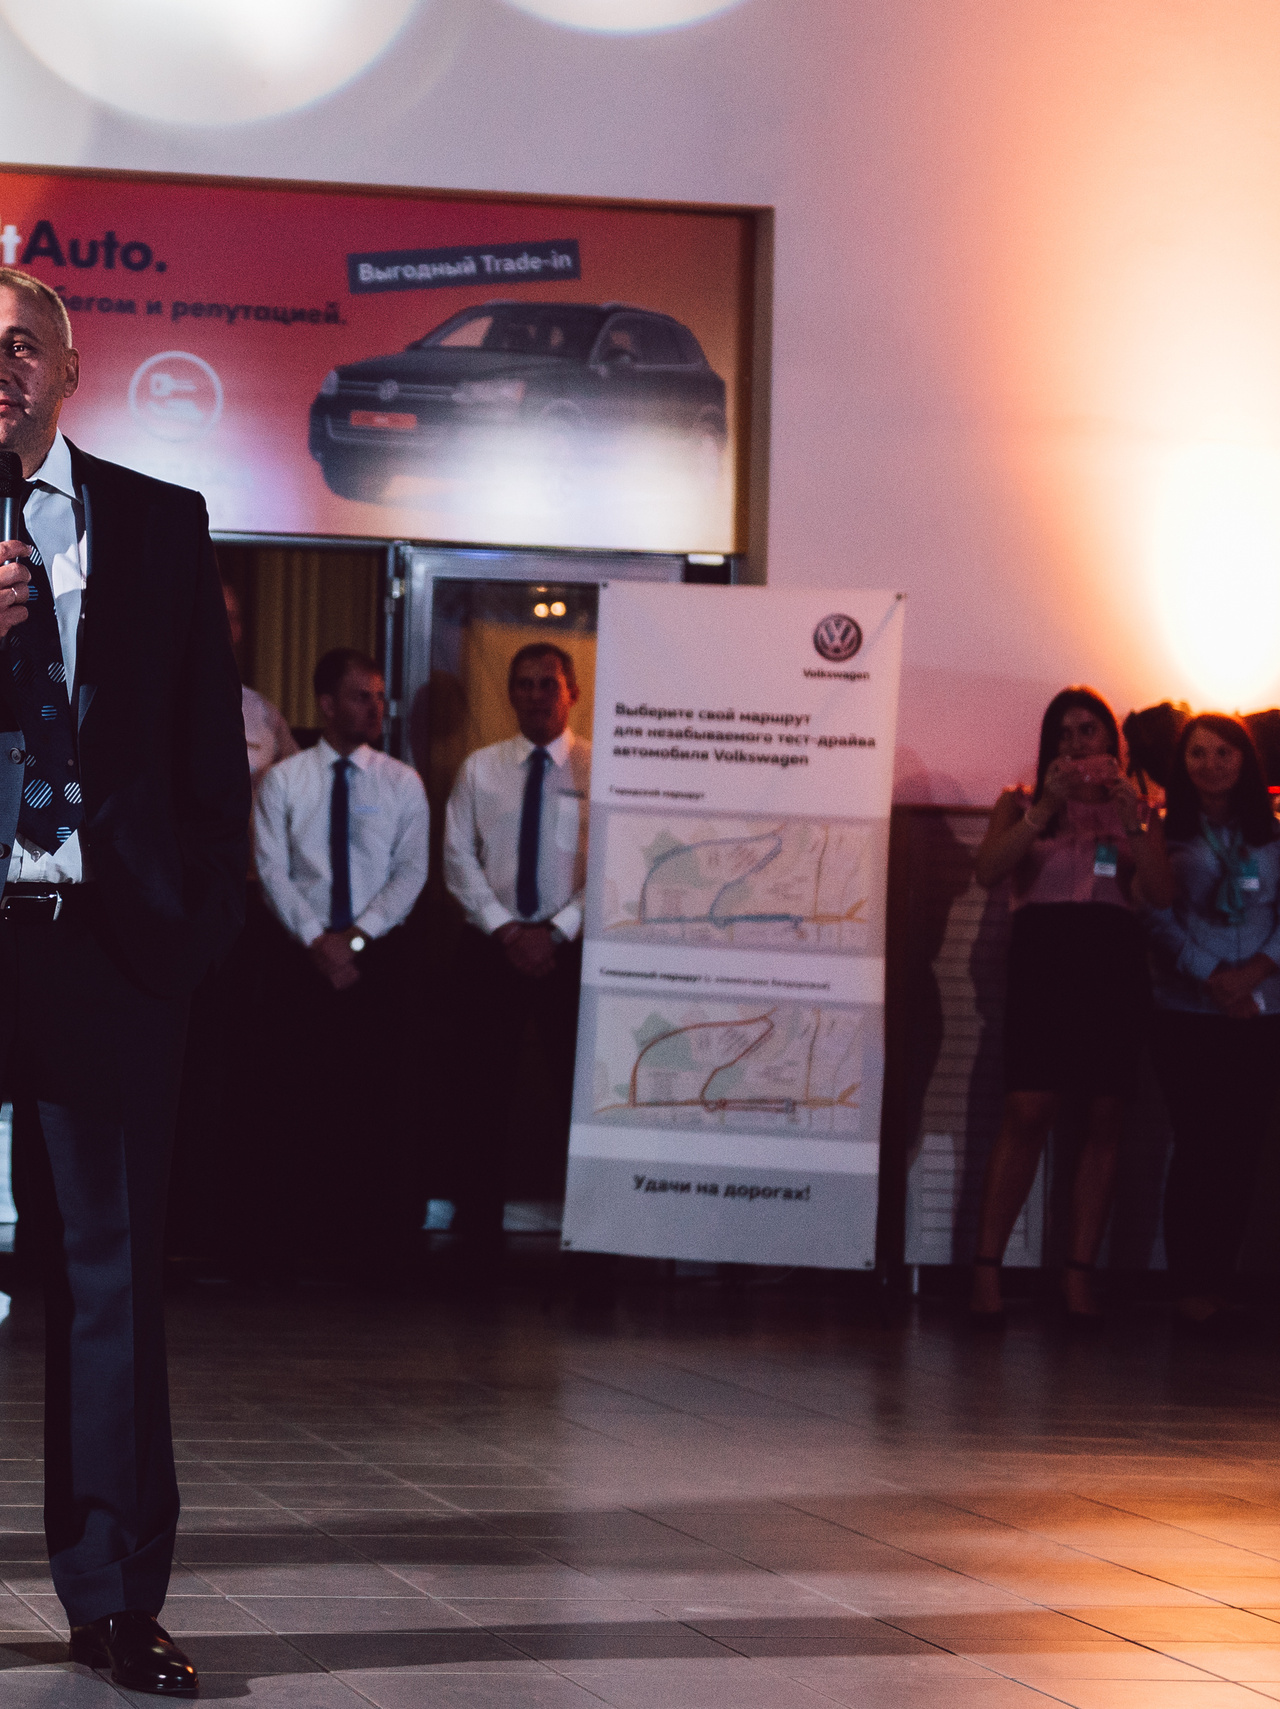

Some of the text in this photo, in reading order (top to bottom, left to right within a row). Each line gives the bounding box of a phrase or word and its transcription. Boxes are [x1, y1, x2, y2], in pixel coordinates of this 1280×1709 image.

[358, 250, 572, 283] Выгодный Trade-in
[146, 300, 163, 315] и
[803, 667, 870, 681] Volkswagen
[615, 703, 812, 727] Выберите свой маршрут
[614, 726, 643, 738] для
[613, 745, 809, 767] автомобиля Volkswagen
[633, 1175, 811, 1202] Удачи на дорогах!
